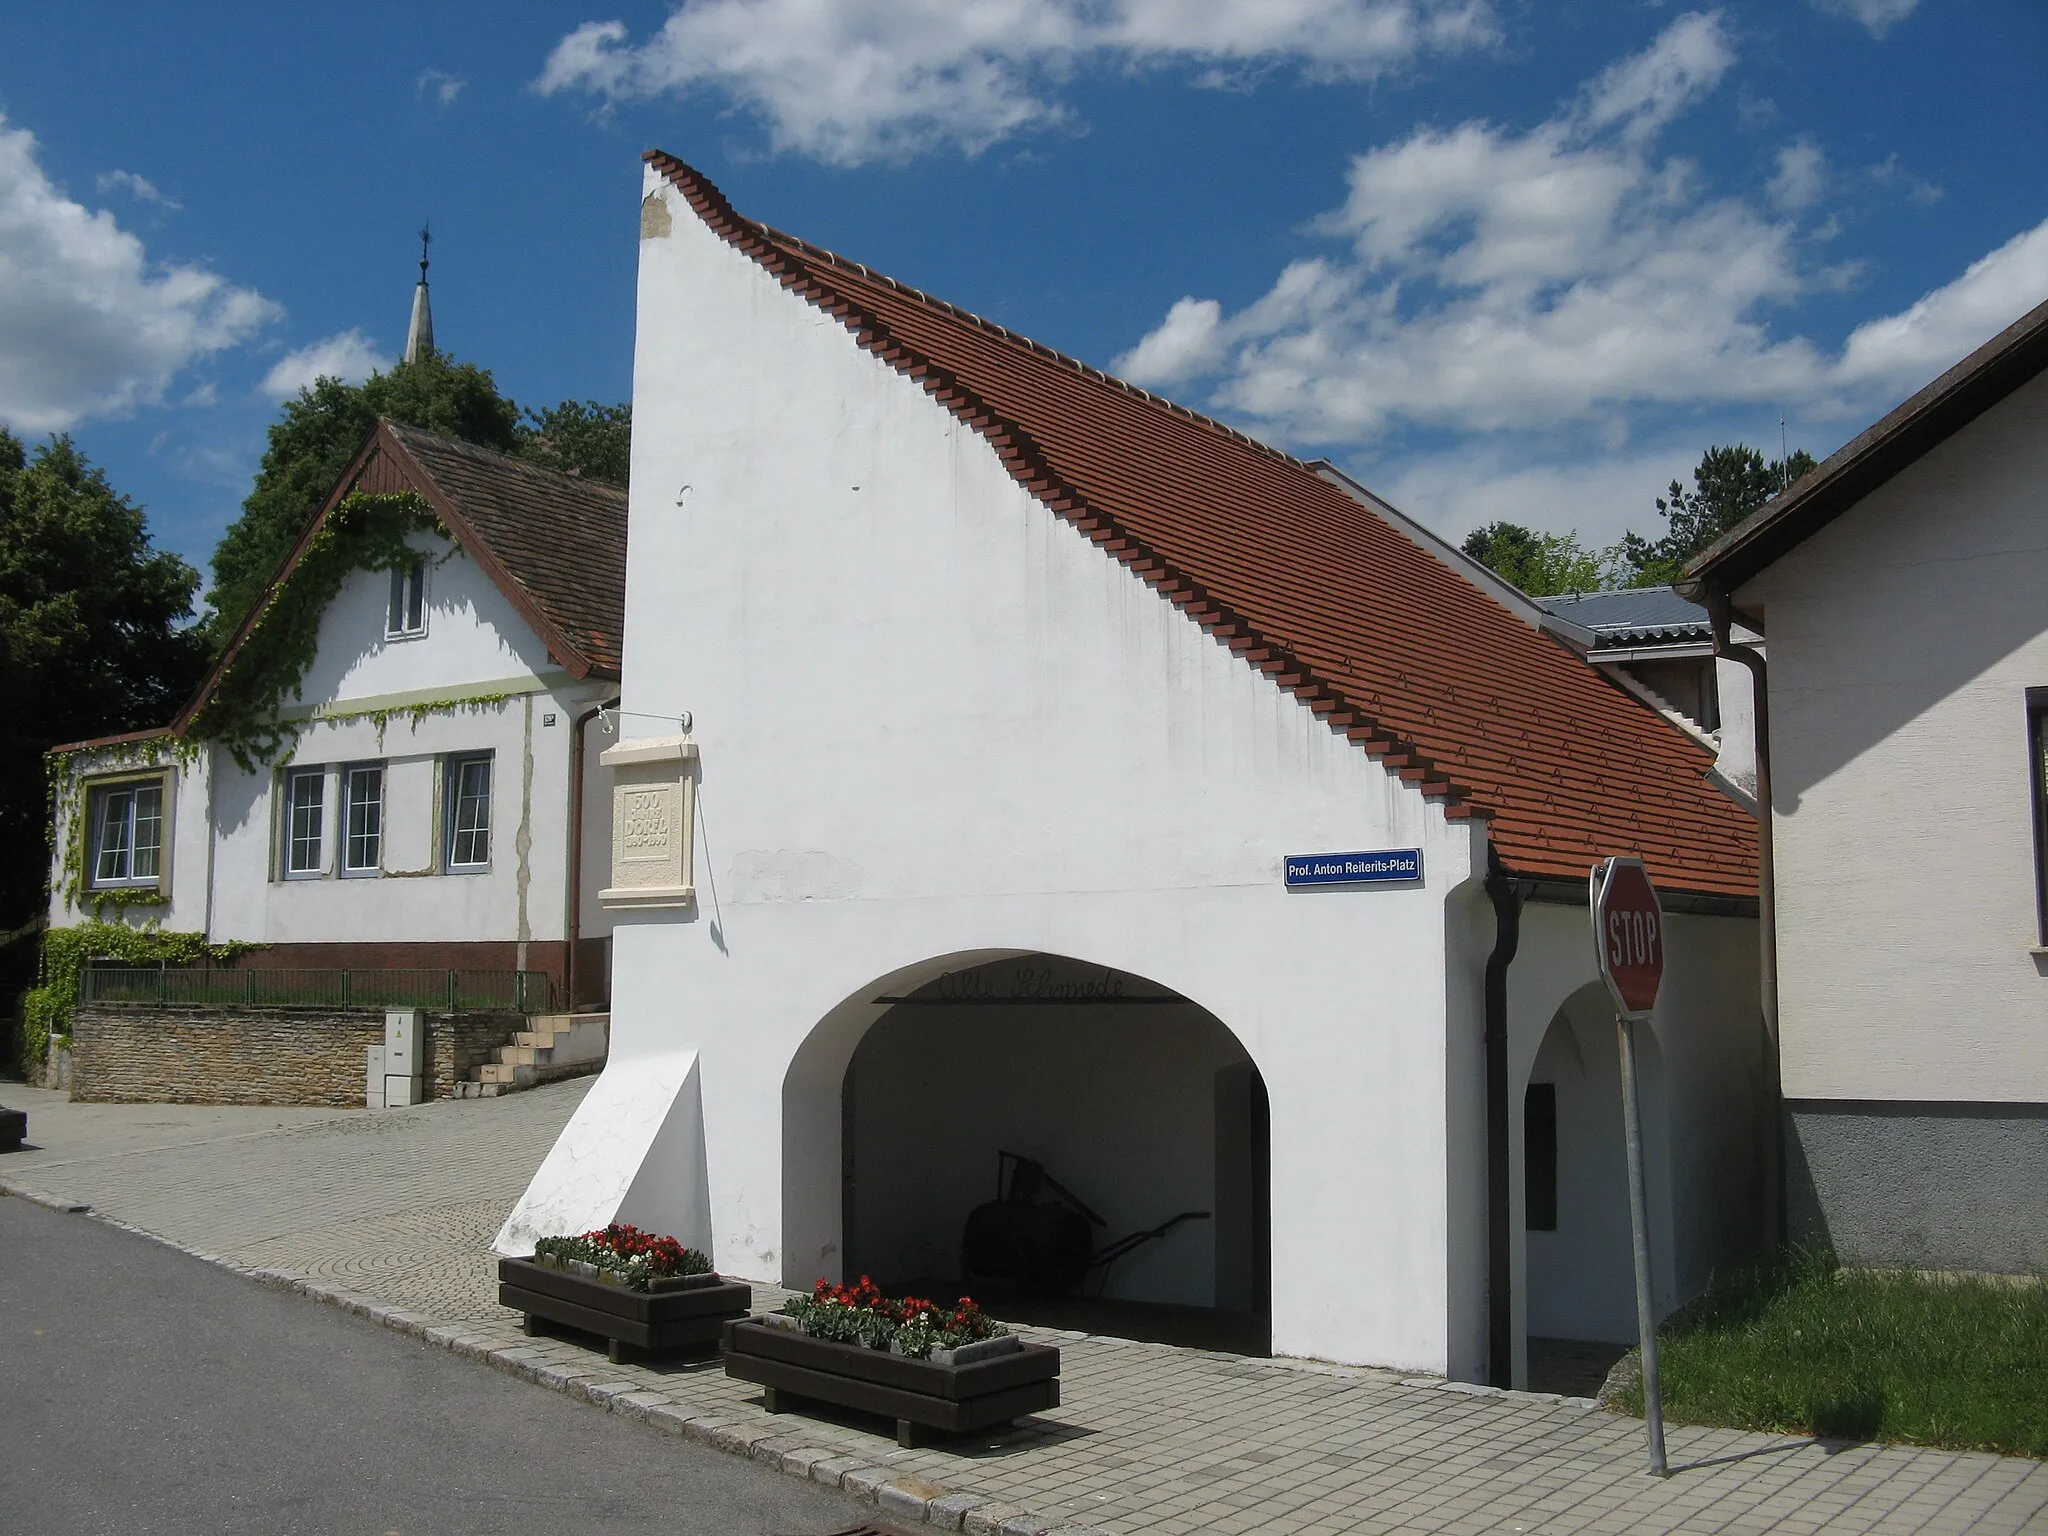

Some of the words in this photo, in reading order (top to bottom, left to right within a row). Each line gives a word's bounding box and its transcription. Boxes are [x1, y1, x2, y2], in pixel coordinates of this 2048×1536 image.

[1288, 865, 1312, 877] Prof.
[1313, 863, 1343, 875] Anton
[1345, 859, 1415, 874] Reiterits-Platz
[1610, 911, 1657, 966] STOP
[939, 972, 995, 998] Alte
